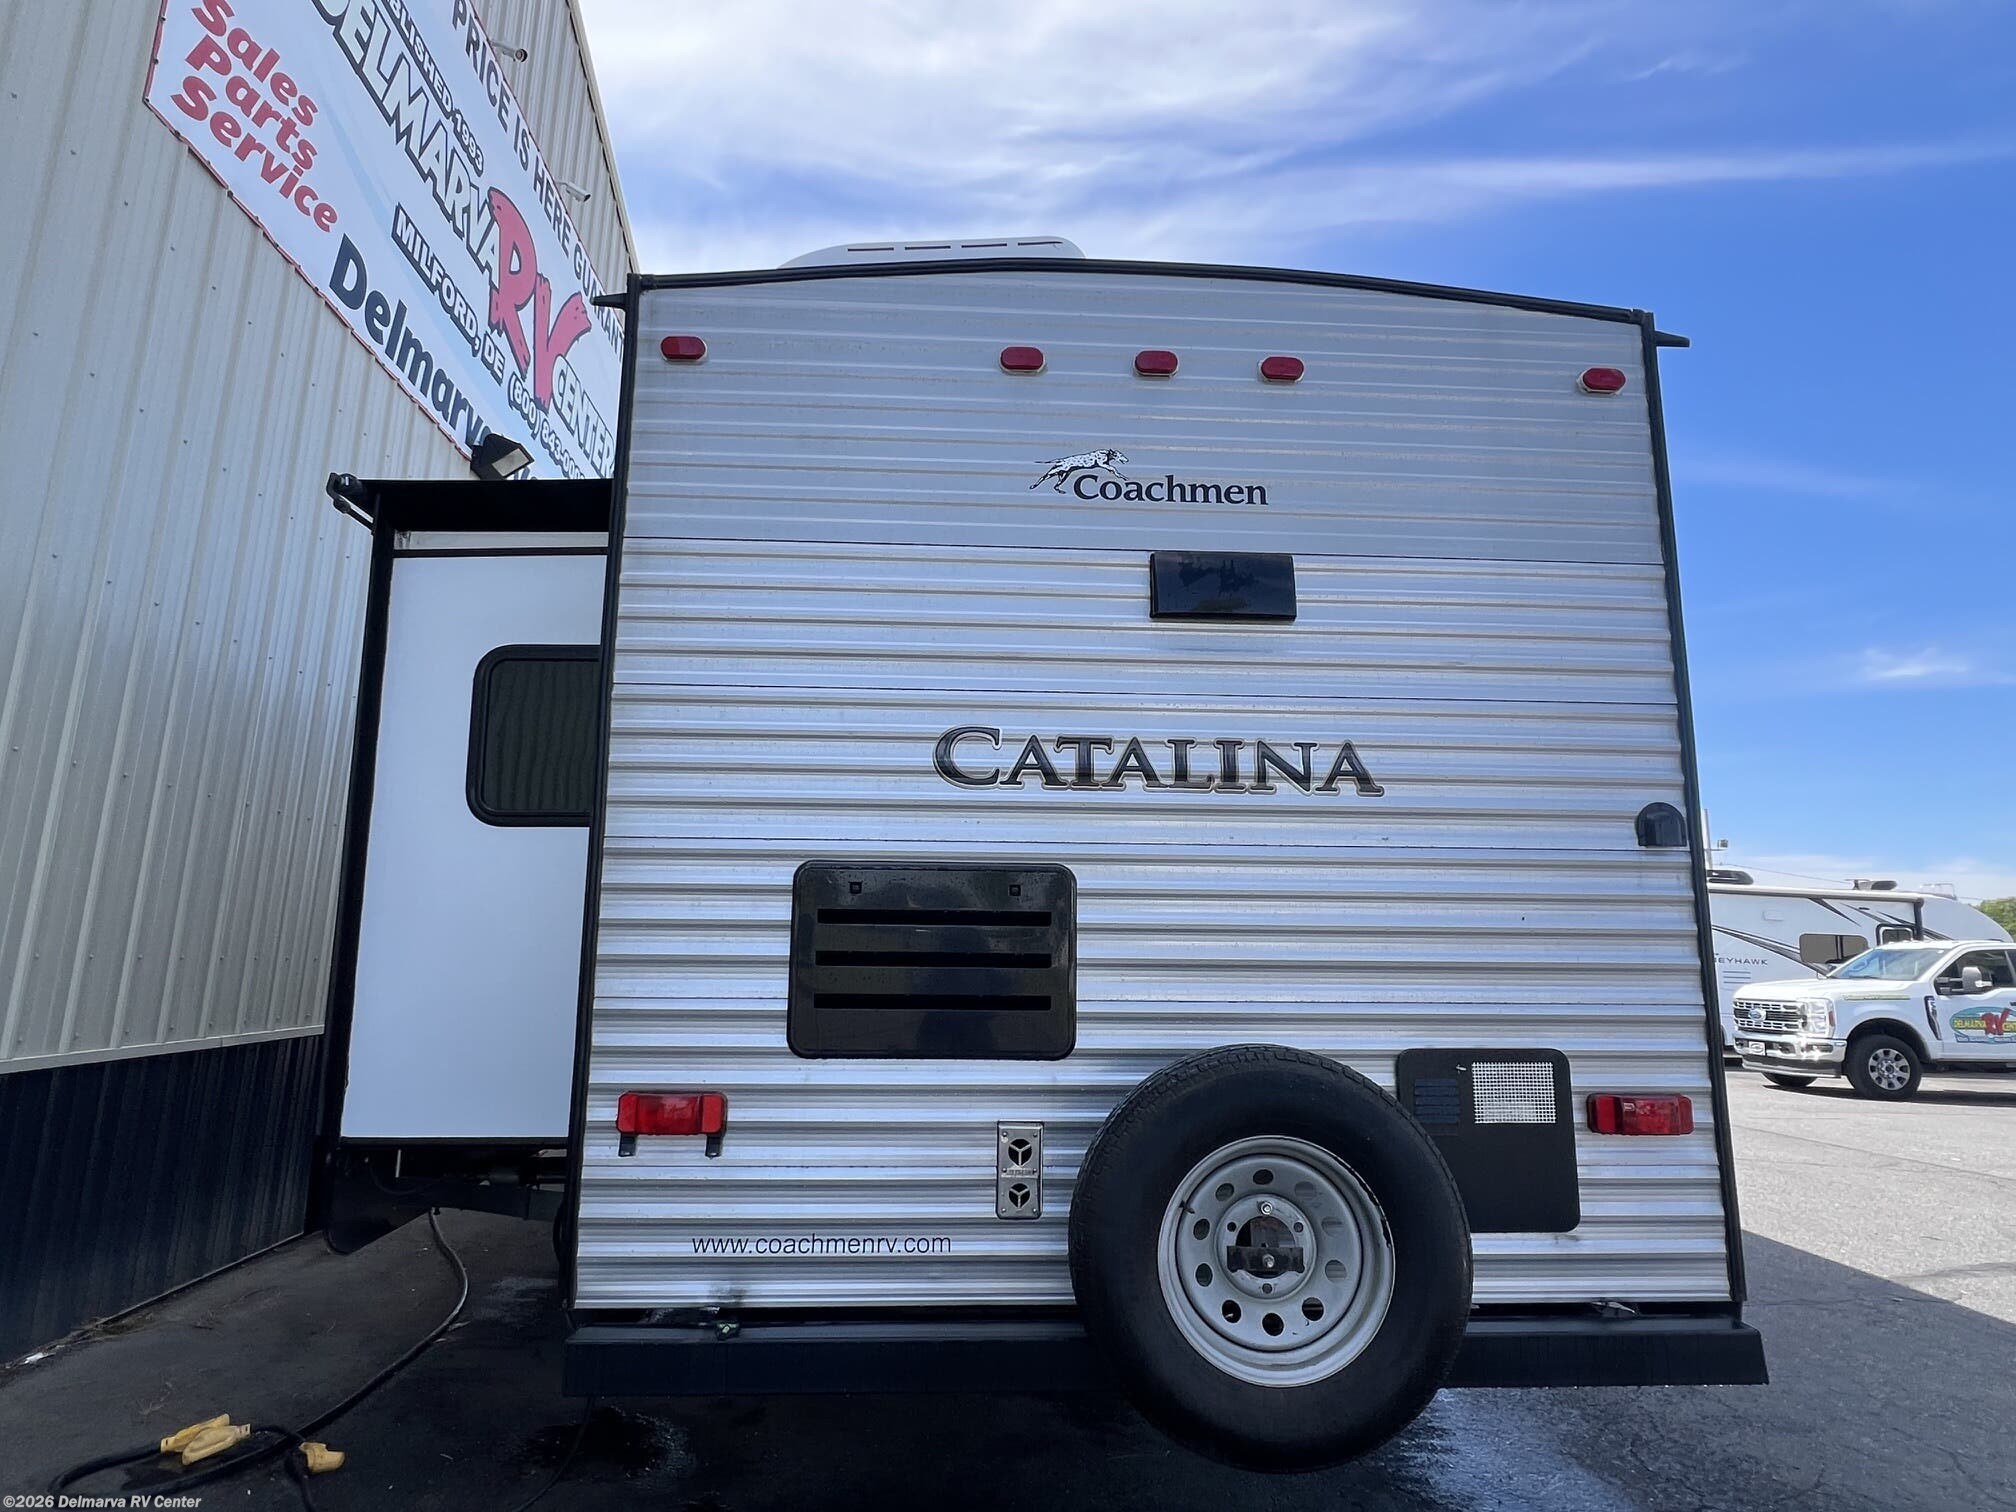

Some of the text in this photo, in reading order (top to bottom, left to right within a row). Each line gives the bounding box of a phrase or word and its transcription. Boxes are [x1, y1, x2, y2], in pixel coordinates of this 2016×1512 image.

[185, 34, 318, 170] Parts
[191, 0, 318, 126] Sales
[453, 0, 511, 133] PRICE
[514, 115, 531, 172] IS
[534, 155, 572, 260] HERE
[170, 75, 338, 233] Service
[452, 108, 484, 177] 1993
[391, 202, 482, 358] MILFORD,
[481, 331, 506, 386] DE
[508, 372, 542, 440] (800)
[487, 186, 592, 414] RV
[552, 354, 616, 479] CENTER
[1073, 474, 1269, 506] Coachmen
[932, 725, 1385, 797] CATALINA
